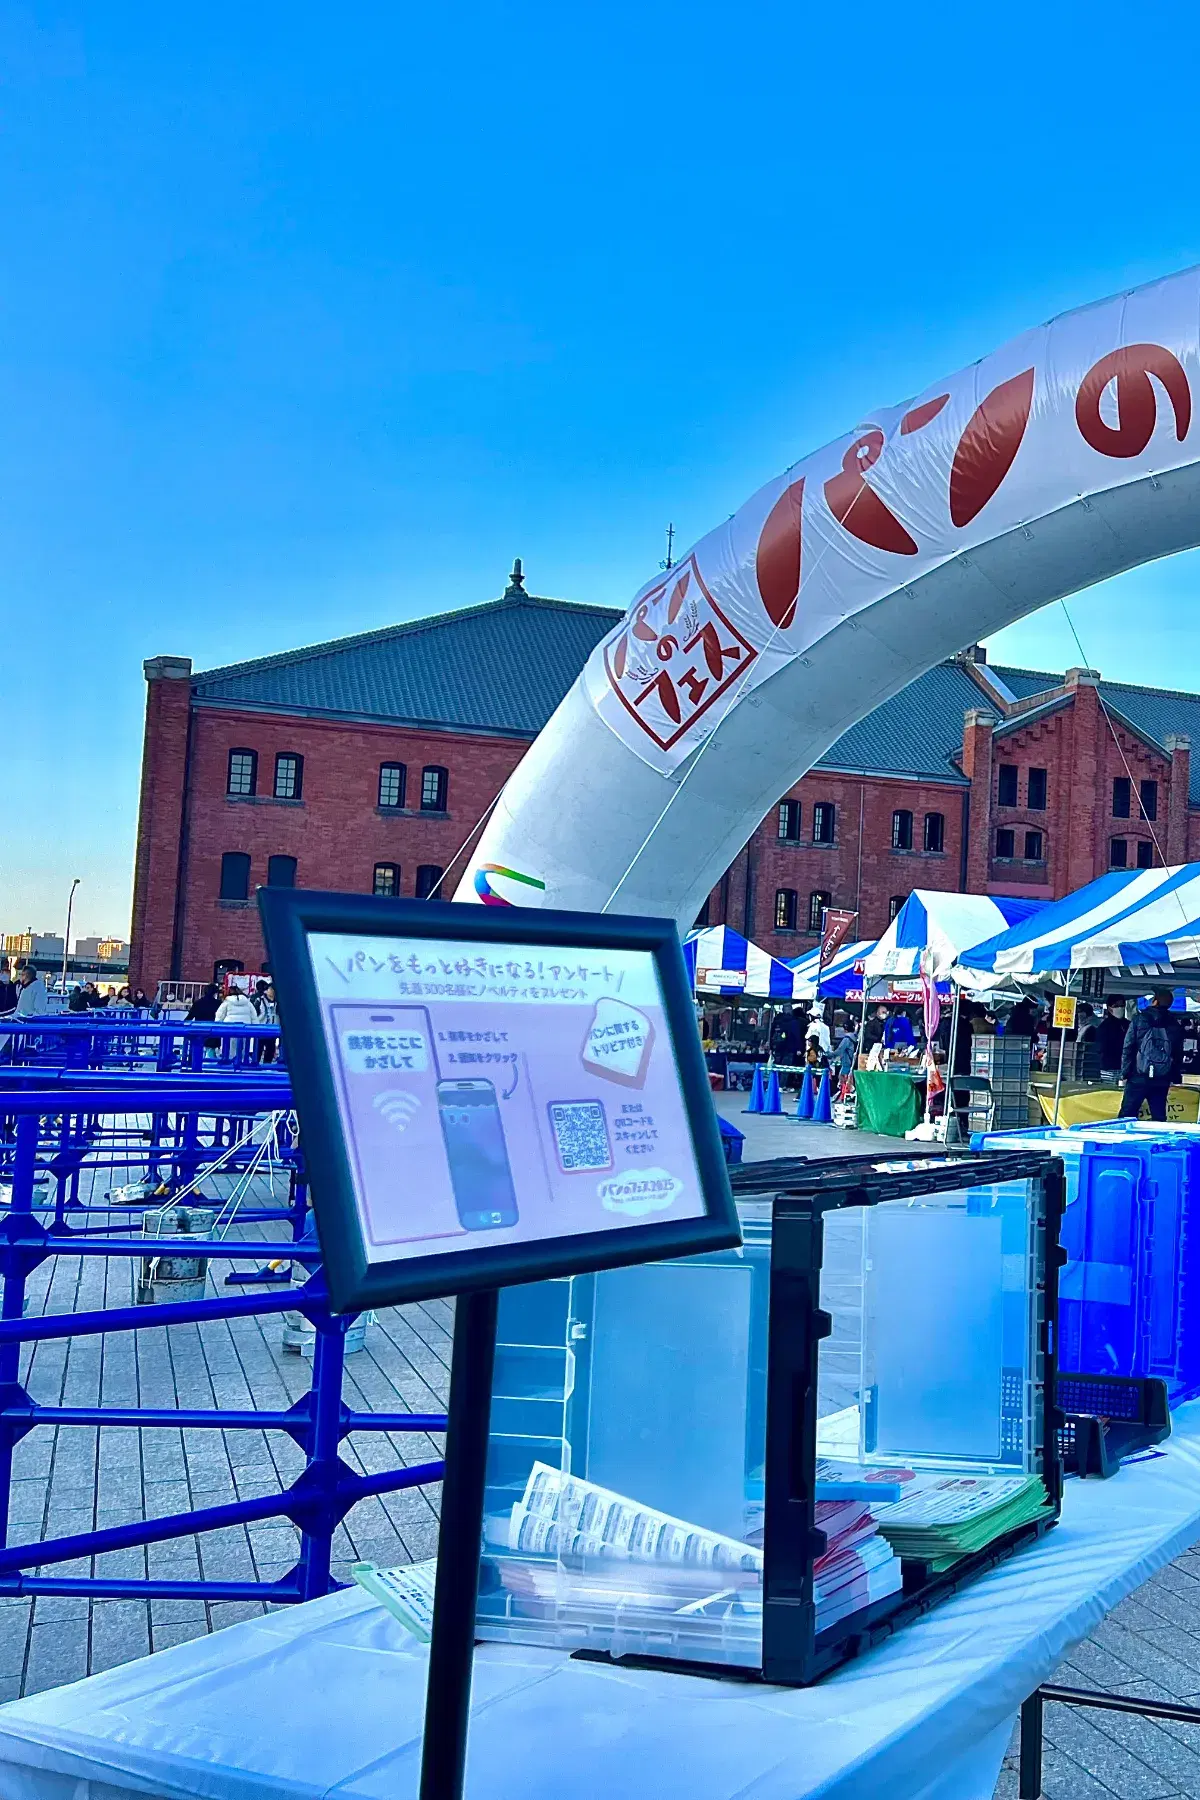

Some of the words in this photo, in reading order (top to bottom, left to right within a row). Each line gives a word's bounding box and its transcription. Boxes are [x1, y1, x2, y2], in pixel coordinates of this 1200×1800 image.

[347, 1035, 423, 1050] 携帯をここに
[364, 1055, 414, 1069] かざして
